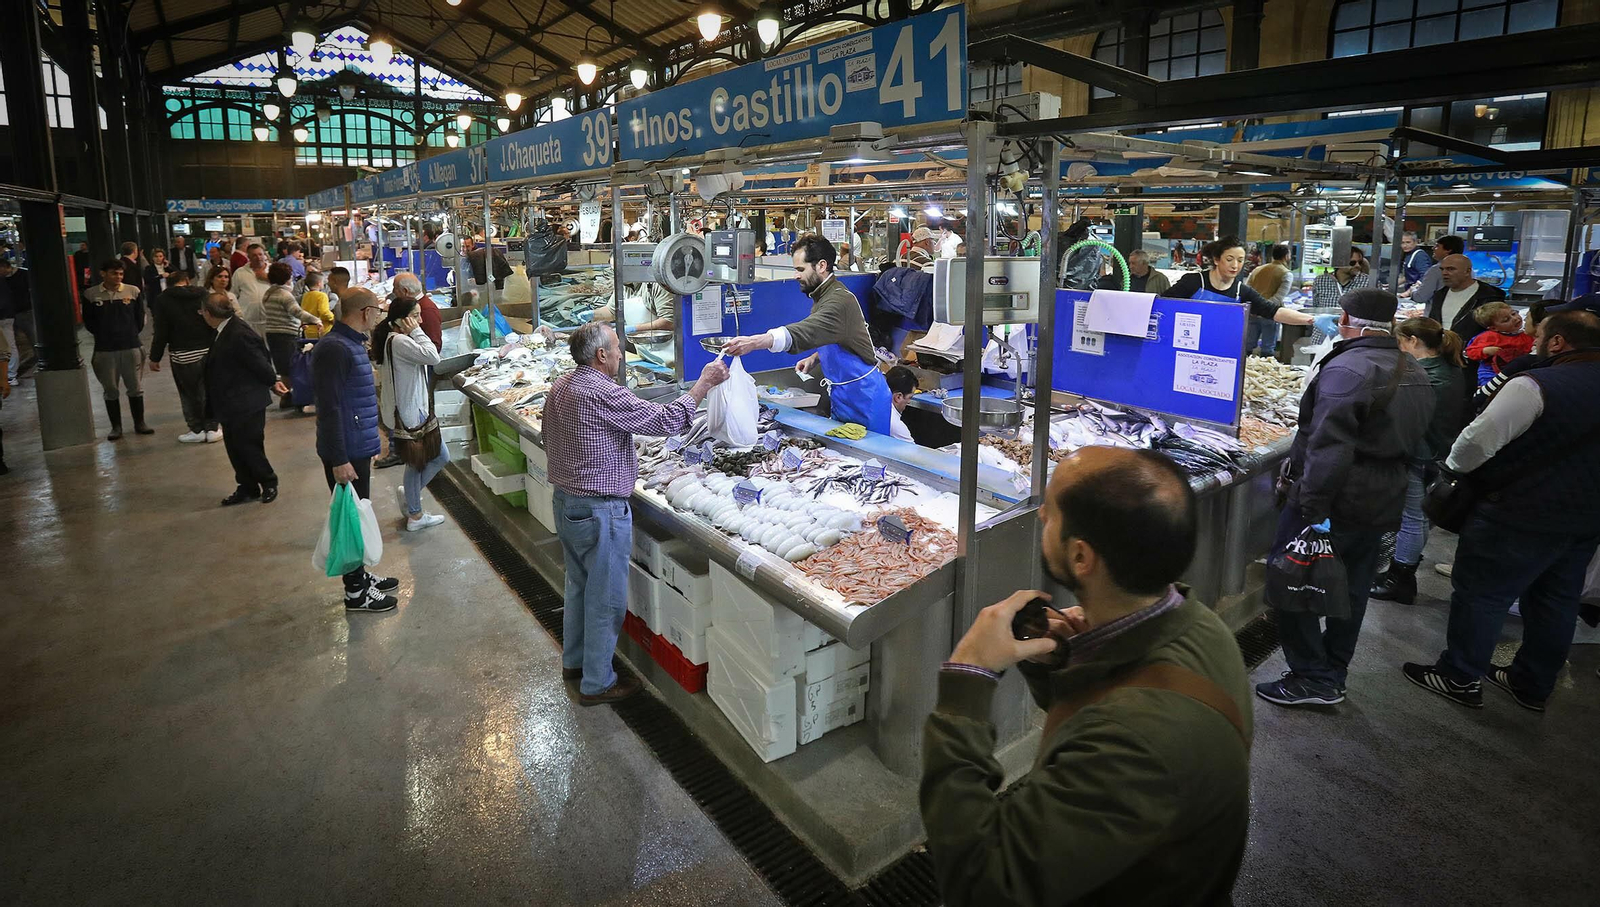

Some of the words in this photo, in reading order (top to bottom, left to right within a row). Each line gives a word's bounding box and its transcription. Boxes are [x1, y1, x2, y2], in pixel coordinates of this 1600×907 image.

[840, 47, 856, 57] PLAZA
[632, 107, 701, 149] Hnos.
[709, 63, 843, 135] Castillo
[879, 12, 961, 118] 41
[500, 133, 562, 174] J.Chaqueta
[581, 111, 610, 167] 39
[468, 146, 482, 184] 37
[167, 199, 187, 213] 23
[278, 199, 295, 211] 24
[1176, 385, 1197, 393] LOCAL
[1197, 389, 1231, 398] ASOCIADO
